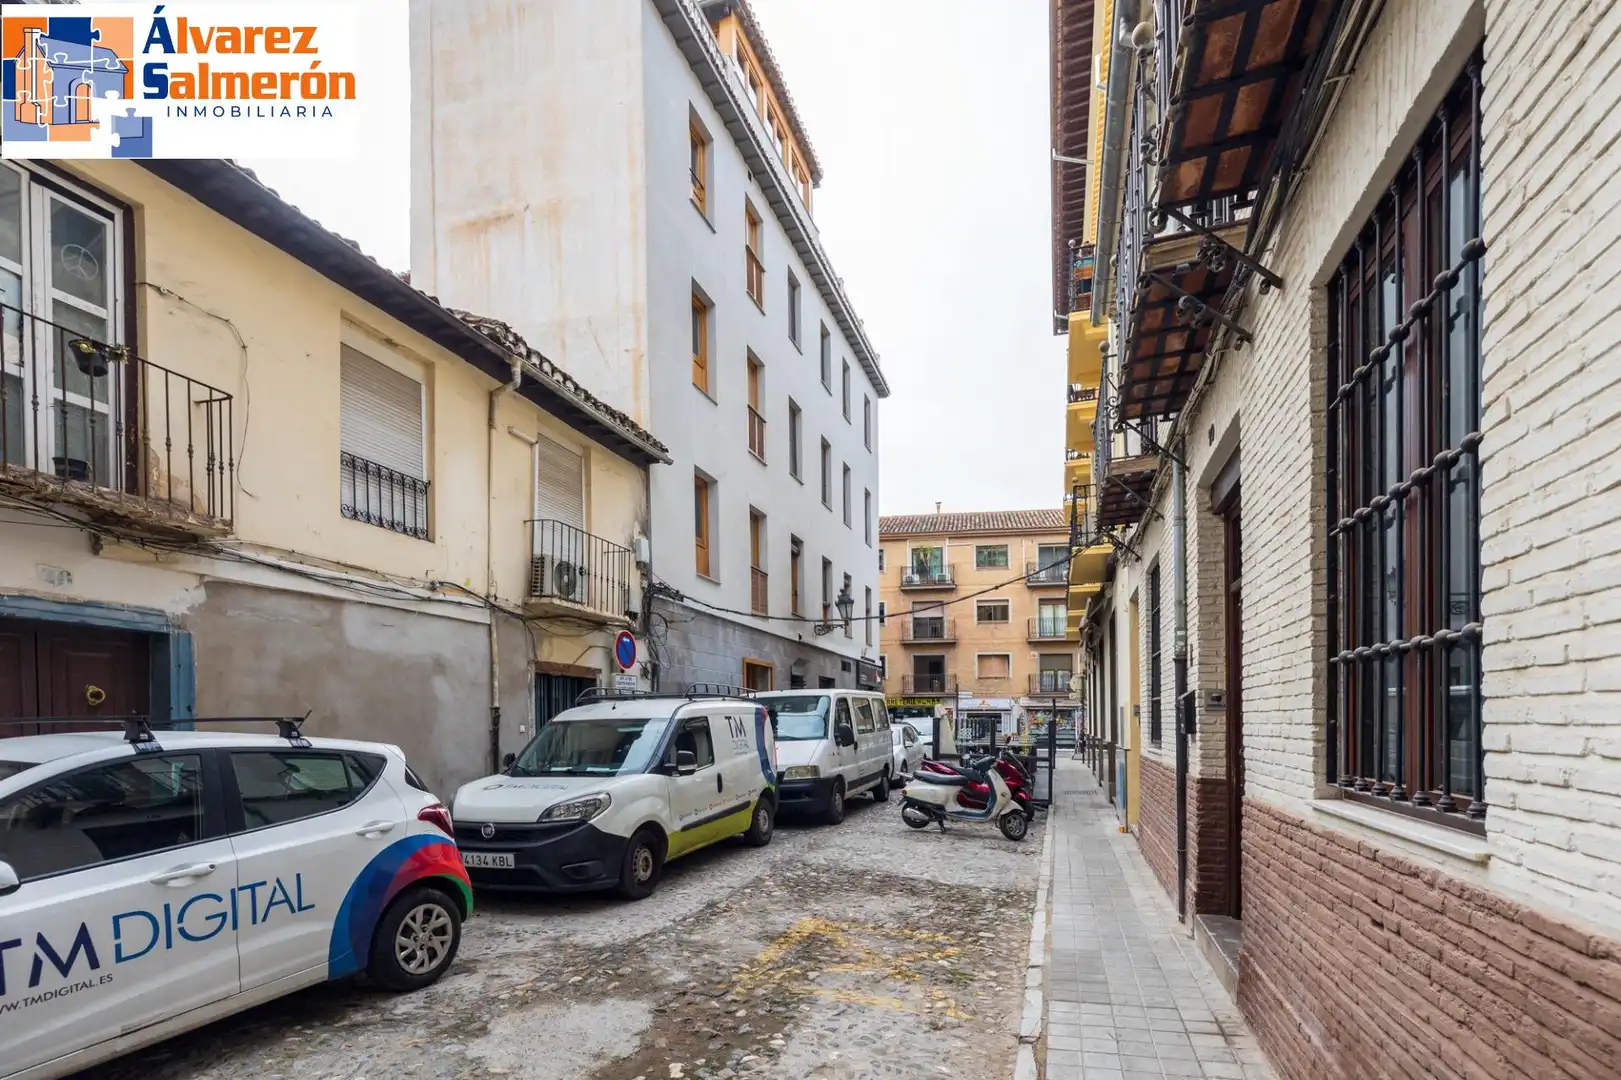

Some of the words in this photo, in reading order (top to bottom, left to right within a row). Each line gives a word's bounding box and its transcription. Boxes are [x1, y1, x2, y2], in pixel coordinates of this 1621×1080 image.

[724, 715, 747, 739] TM
[464, 855, 489, 866] 4134
[492, 855, 513, 867] KBL
[112, 872, 316, 965] DIGITAL
